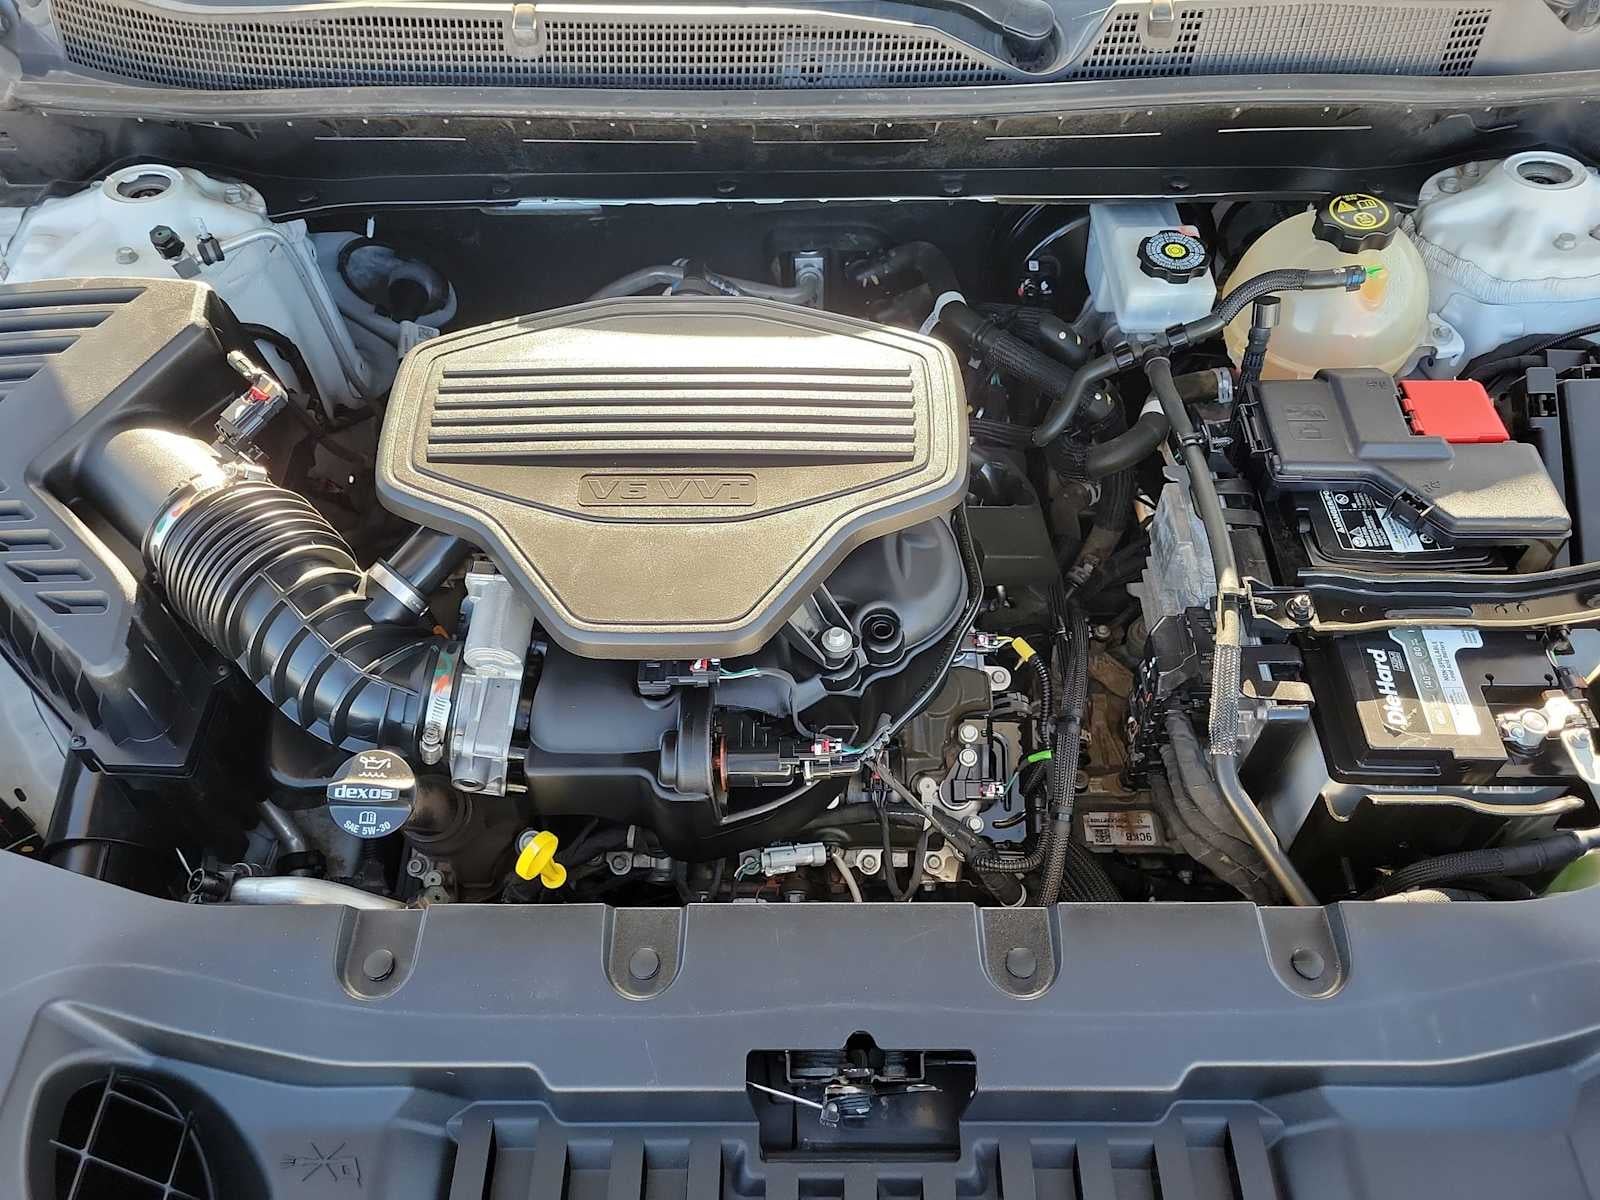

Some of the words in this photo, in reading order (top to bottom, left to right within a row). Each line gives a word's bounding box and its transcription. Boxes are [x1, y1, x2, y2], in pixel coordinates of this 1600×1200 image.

[587, 479, 648, 500] V6
[658, 478, 750, 500] VVT
[1366, 648, 1408, 726] DieHard
[334, 784, 394, 800] dexos
[343, 820, 360, 834] SAE
[361, 821, 391, 836] 5W-30
